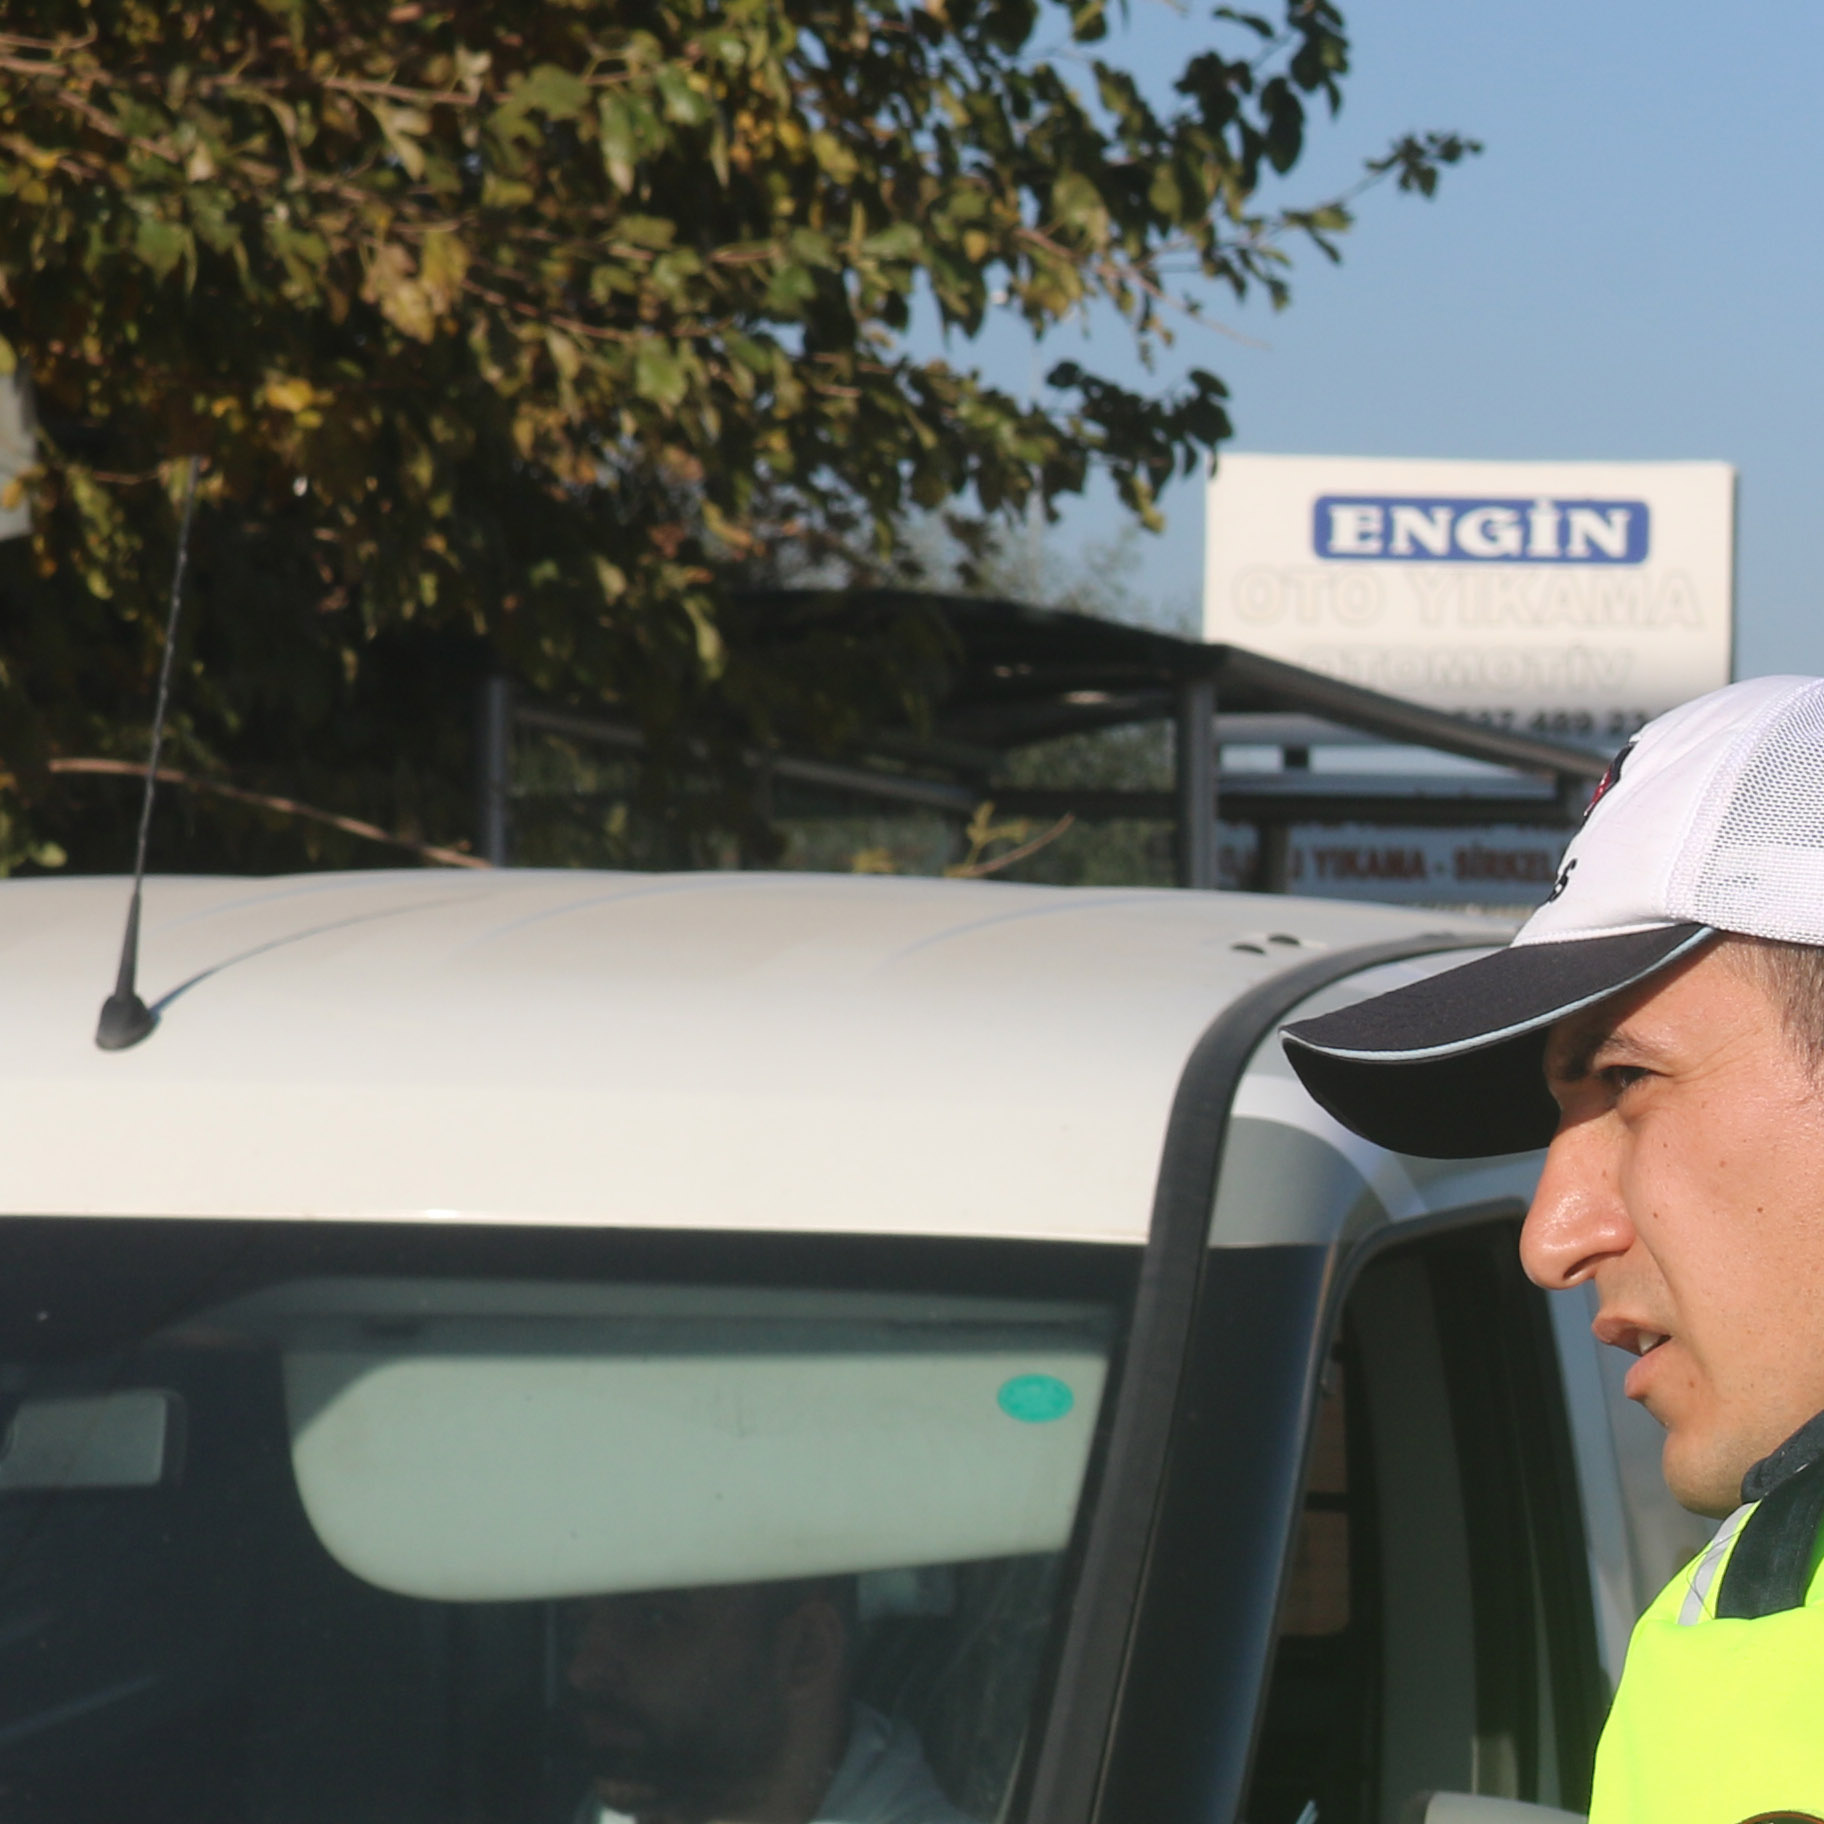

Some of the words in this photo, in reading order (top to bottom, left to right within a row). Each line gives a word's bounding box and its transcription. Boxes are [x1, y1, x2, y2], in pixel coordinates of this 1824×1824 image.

[1325, 500, 1632, 558] ENGİN
[1232, 563, 1387, 628] OTO
[1406, 567, 1706, 632] YIKAMA
